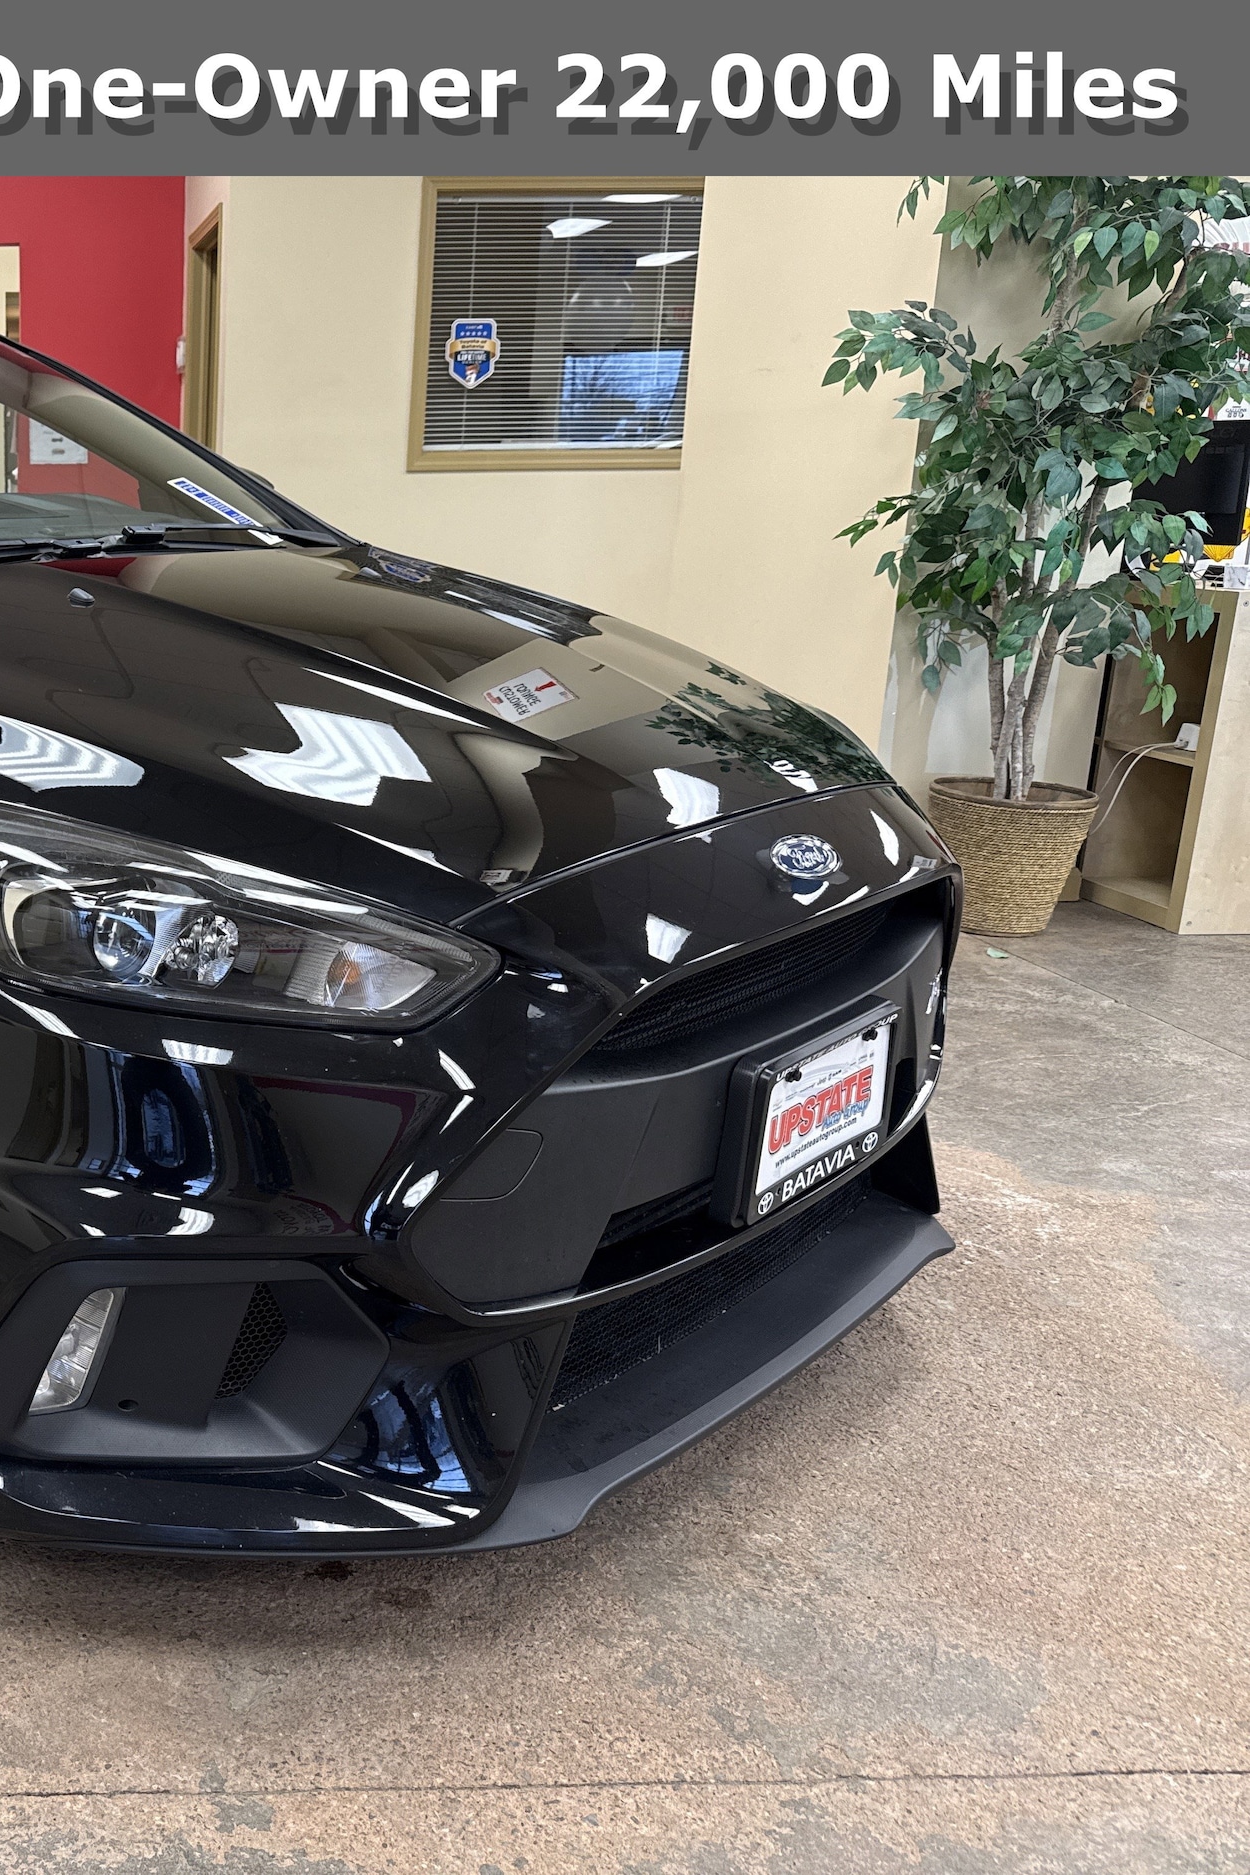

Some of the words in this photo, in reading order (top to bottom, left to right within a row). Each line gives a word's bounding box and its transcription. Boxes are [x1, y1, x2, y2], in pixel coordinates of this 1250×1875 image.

[768, 1065, 874, 1155] UPSTATE
[774, 1116, 857, 1168] www.upstateautogroup.com
[781, 1144, 856, 1202] BATAVIA
